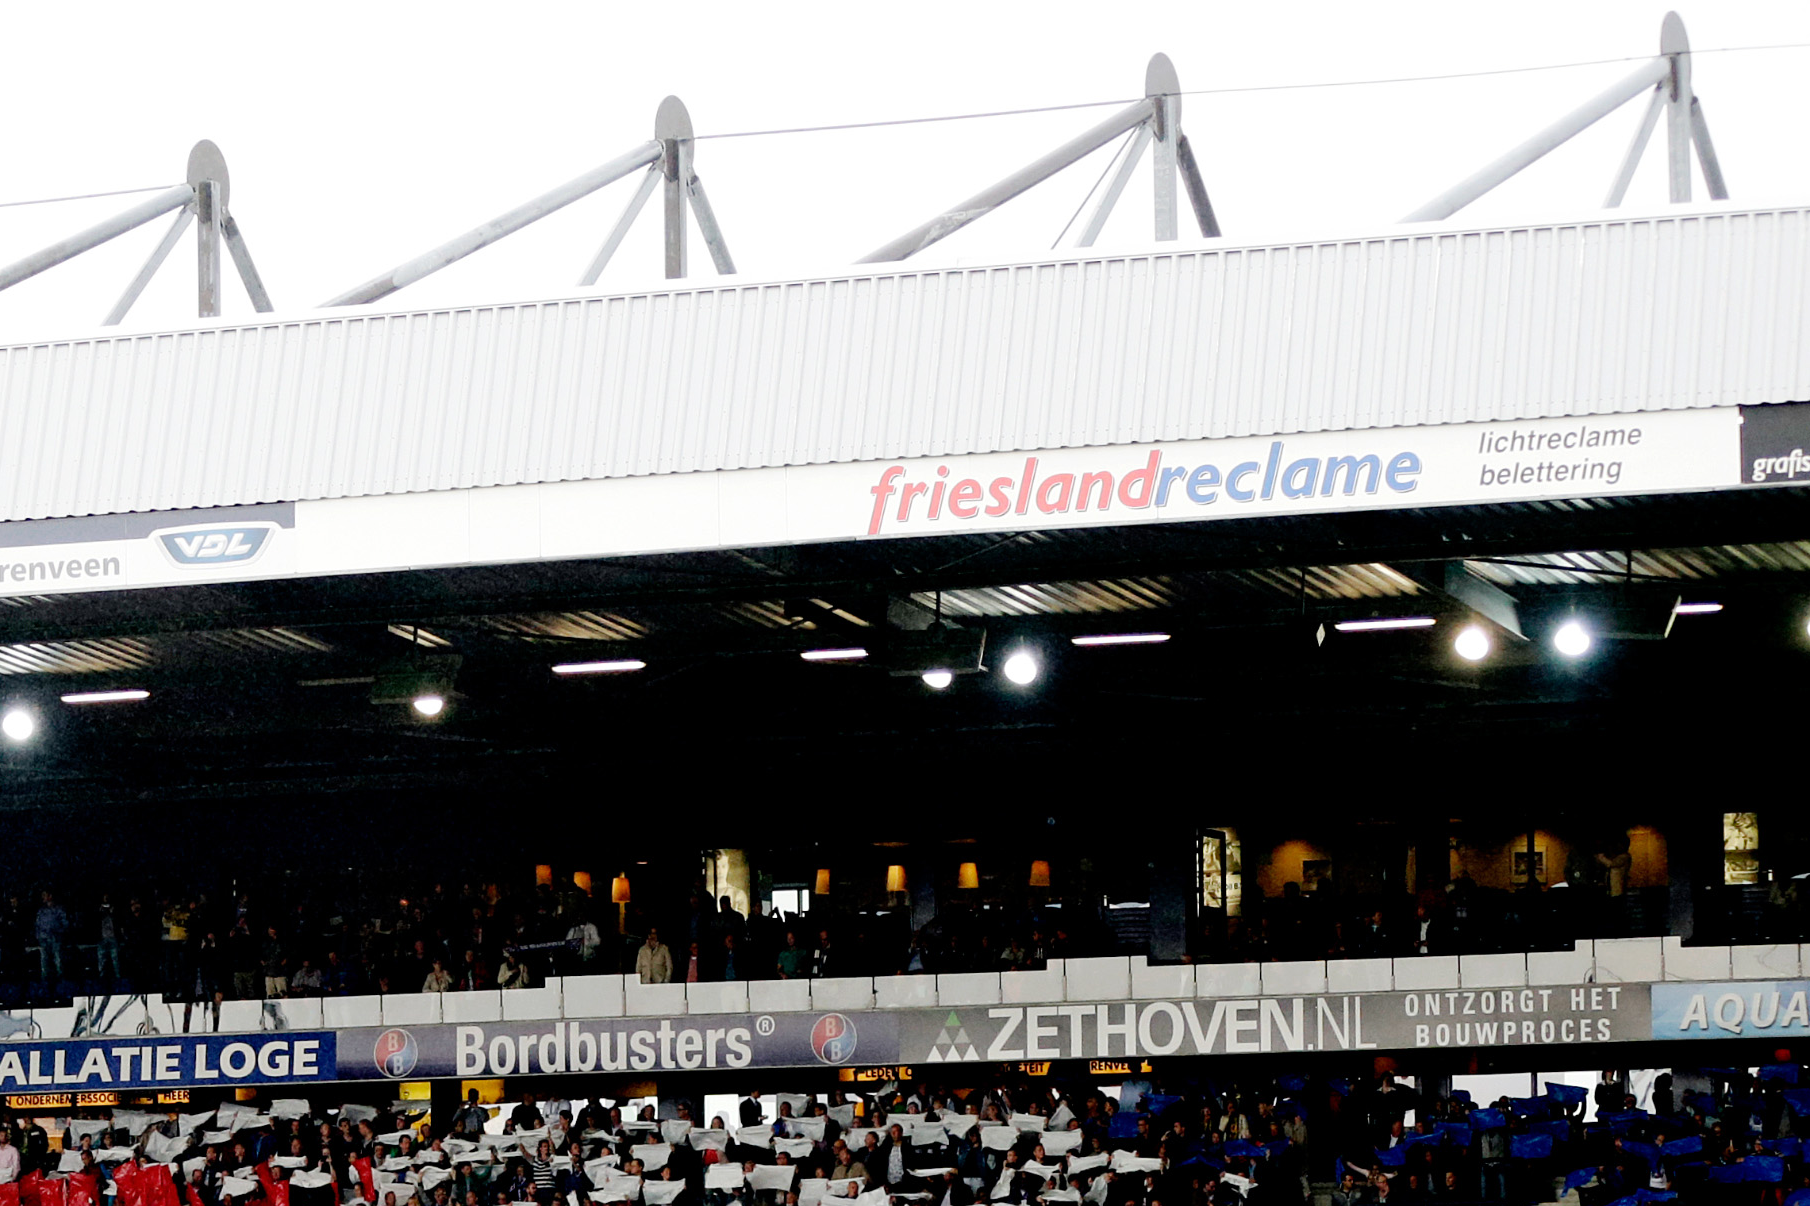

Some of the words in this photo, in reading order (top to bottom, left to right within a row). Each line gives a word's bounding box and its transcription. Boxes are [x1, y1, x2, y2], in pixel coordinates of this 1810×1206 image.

[1477, 425, 1643, 457] lichtreclame
[869, 442, 1422, 536] frieslandreclame
[1478, 458, 1624, 491] belettering
[172, 531, 255, 558] VDL
[1404, 992, 1554, 1018] ONTZORGT
[1570, 986, 1622, 1011] HET
[1678, 990, 1810, 1036] AQUA
[987, 998, 1377, 1061] ZETHOVEN.NL
[1415, 1017, 1612, 1045] BOUWPROCES
[194, 1040, 320, 1079] LOGE
[455, 1022, 753, 1075] Bordbusters
